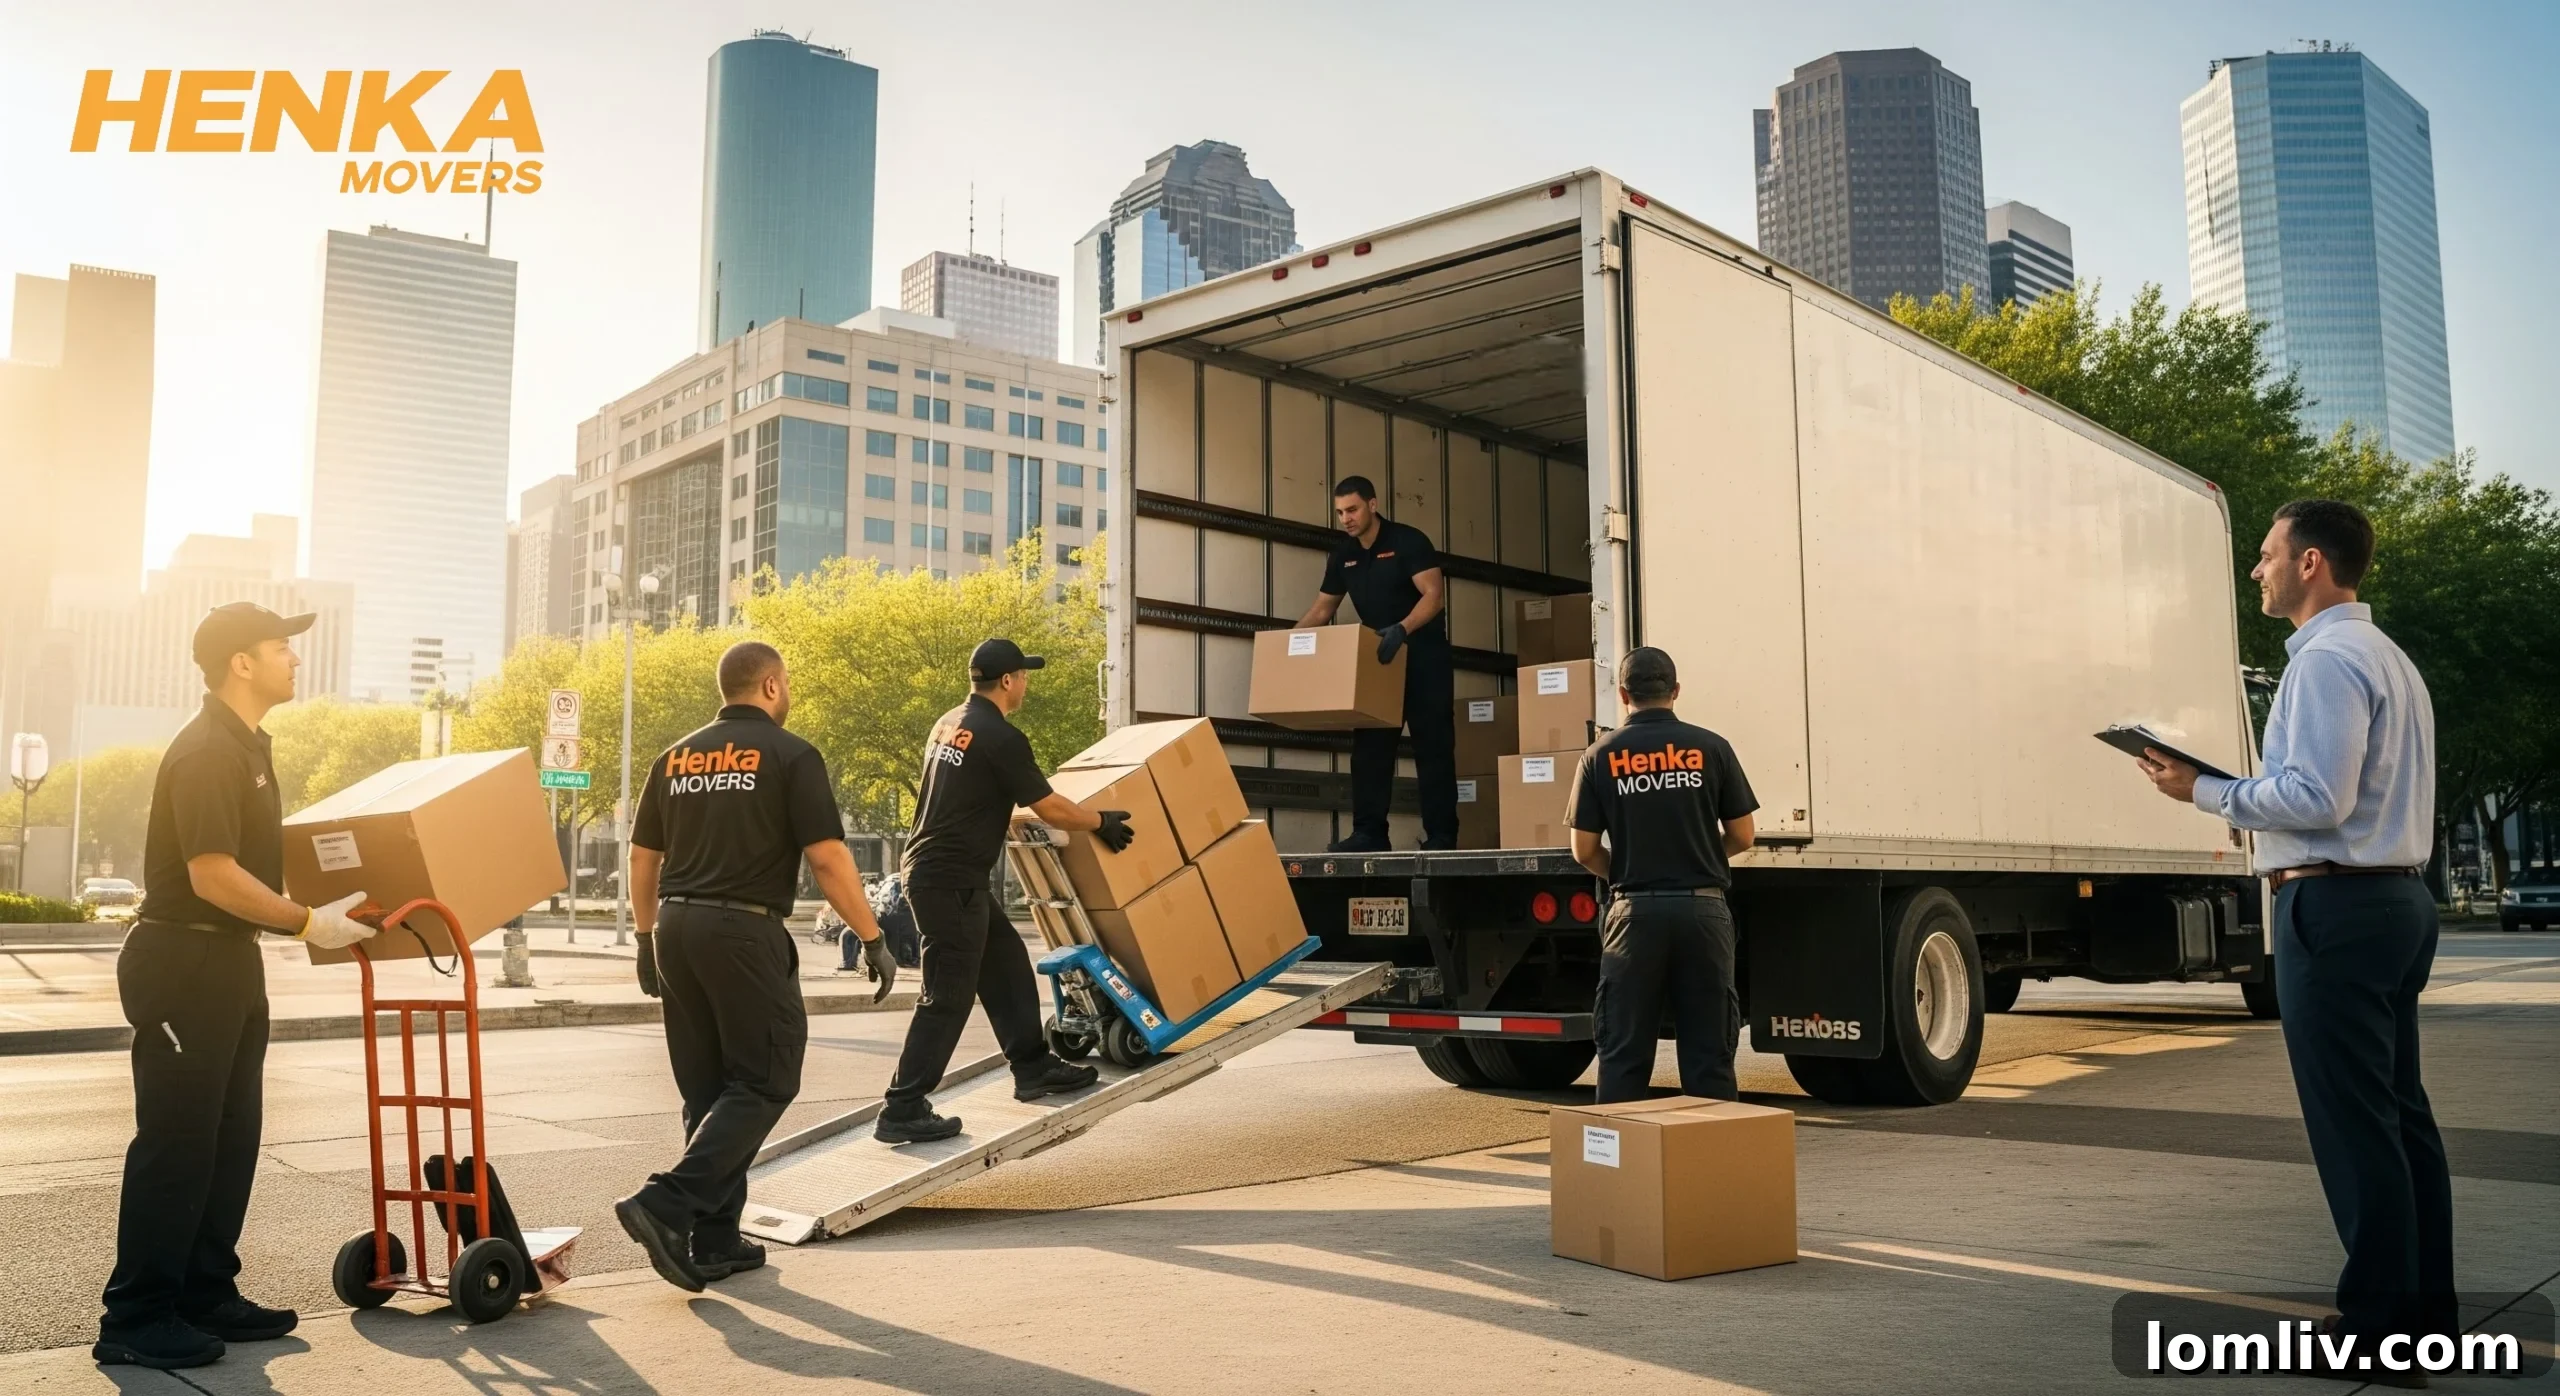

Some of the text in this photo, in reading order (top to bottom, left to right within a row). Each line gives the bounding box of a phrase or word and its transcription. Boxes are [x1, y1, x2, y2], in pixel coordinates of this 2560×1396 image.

[665, 742, 761, 777] Henka
[1608, 743, 1704, 777] Henka
[670, 772, 756, 796] MOVERS
[1617, 771, 1703, 796] MOVERS
